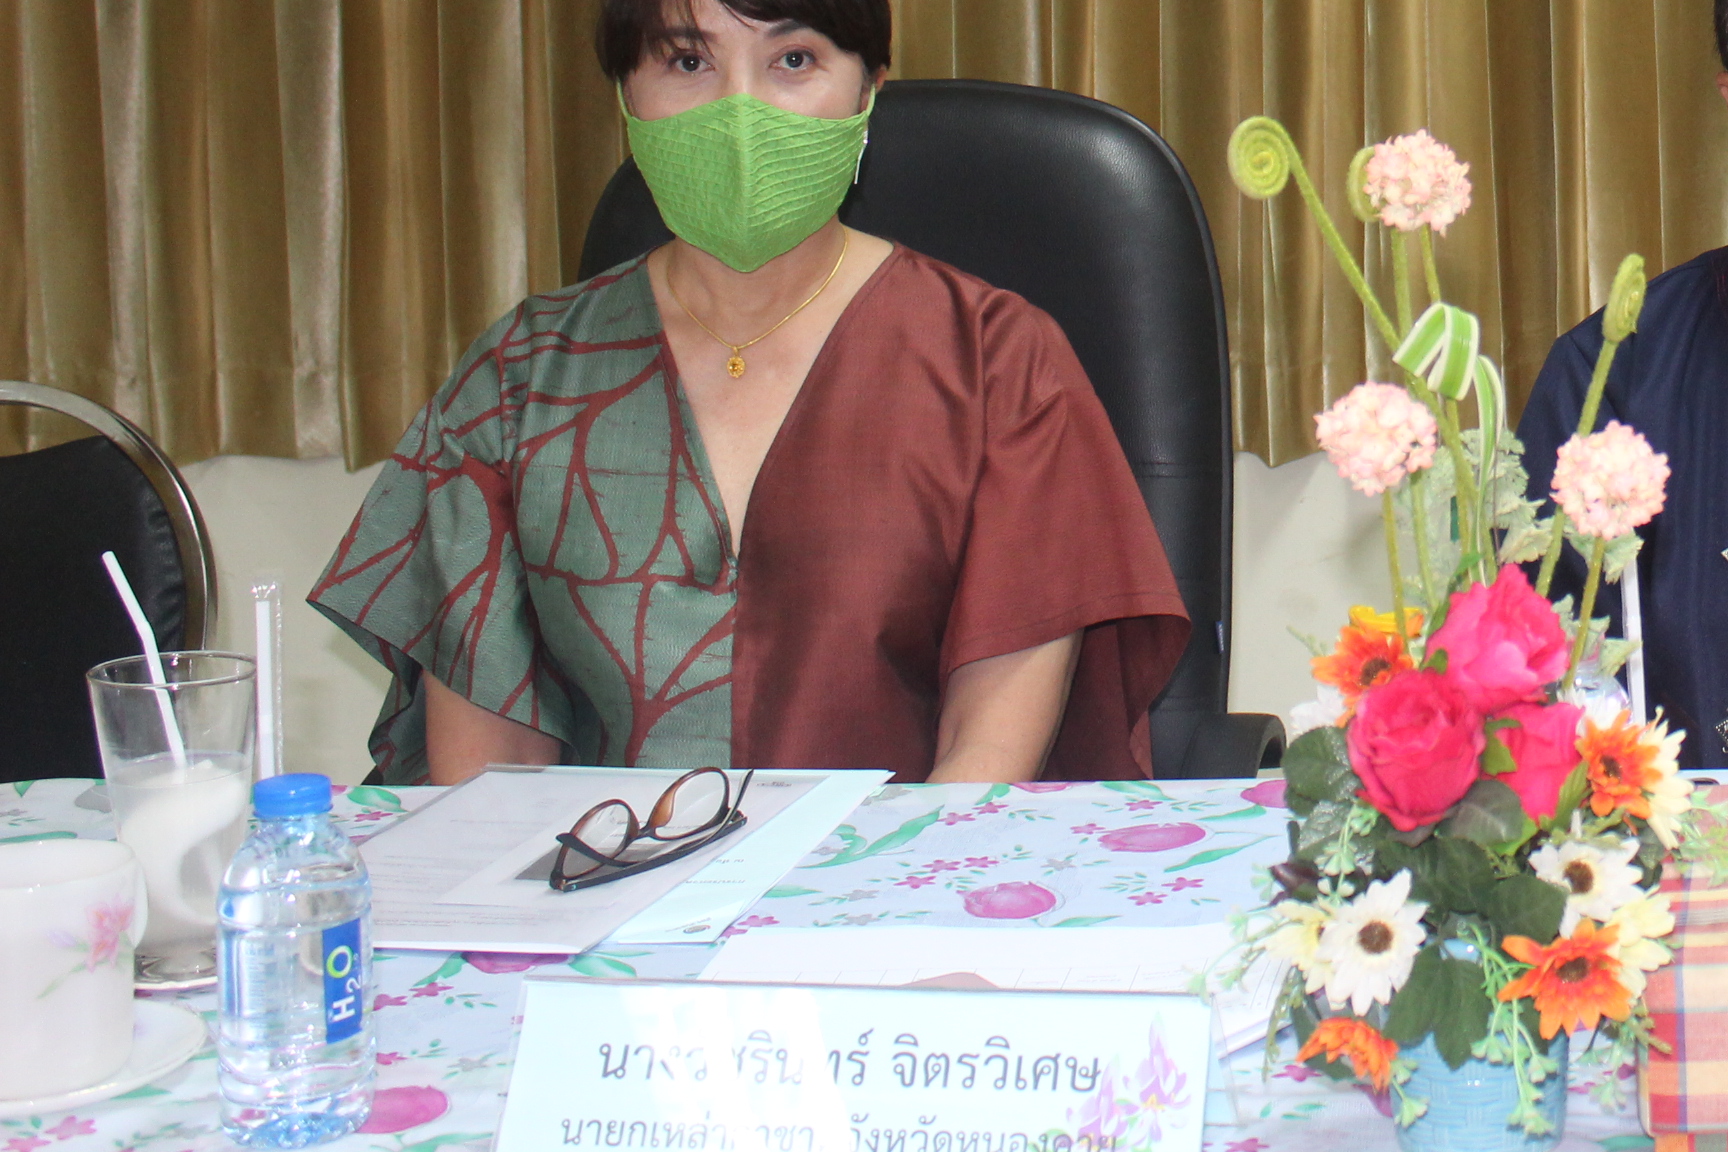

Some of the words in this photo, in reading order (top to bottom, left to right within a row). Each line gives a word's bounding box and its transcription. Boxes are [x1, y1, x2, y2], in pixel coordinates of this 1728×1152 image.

[598, 1028, 873, 1088] นางวรินร์
[891, 1033, 1101, 1093] จิตรวิเศษ
